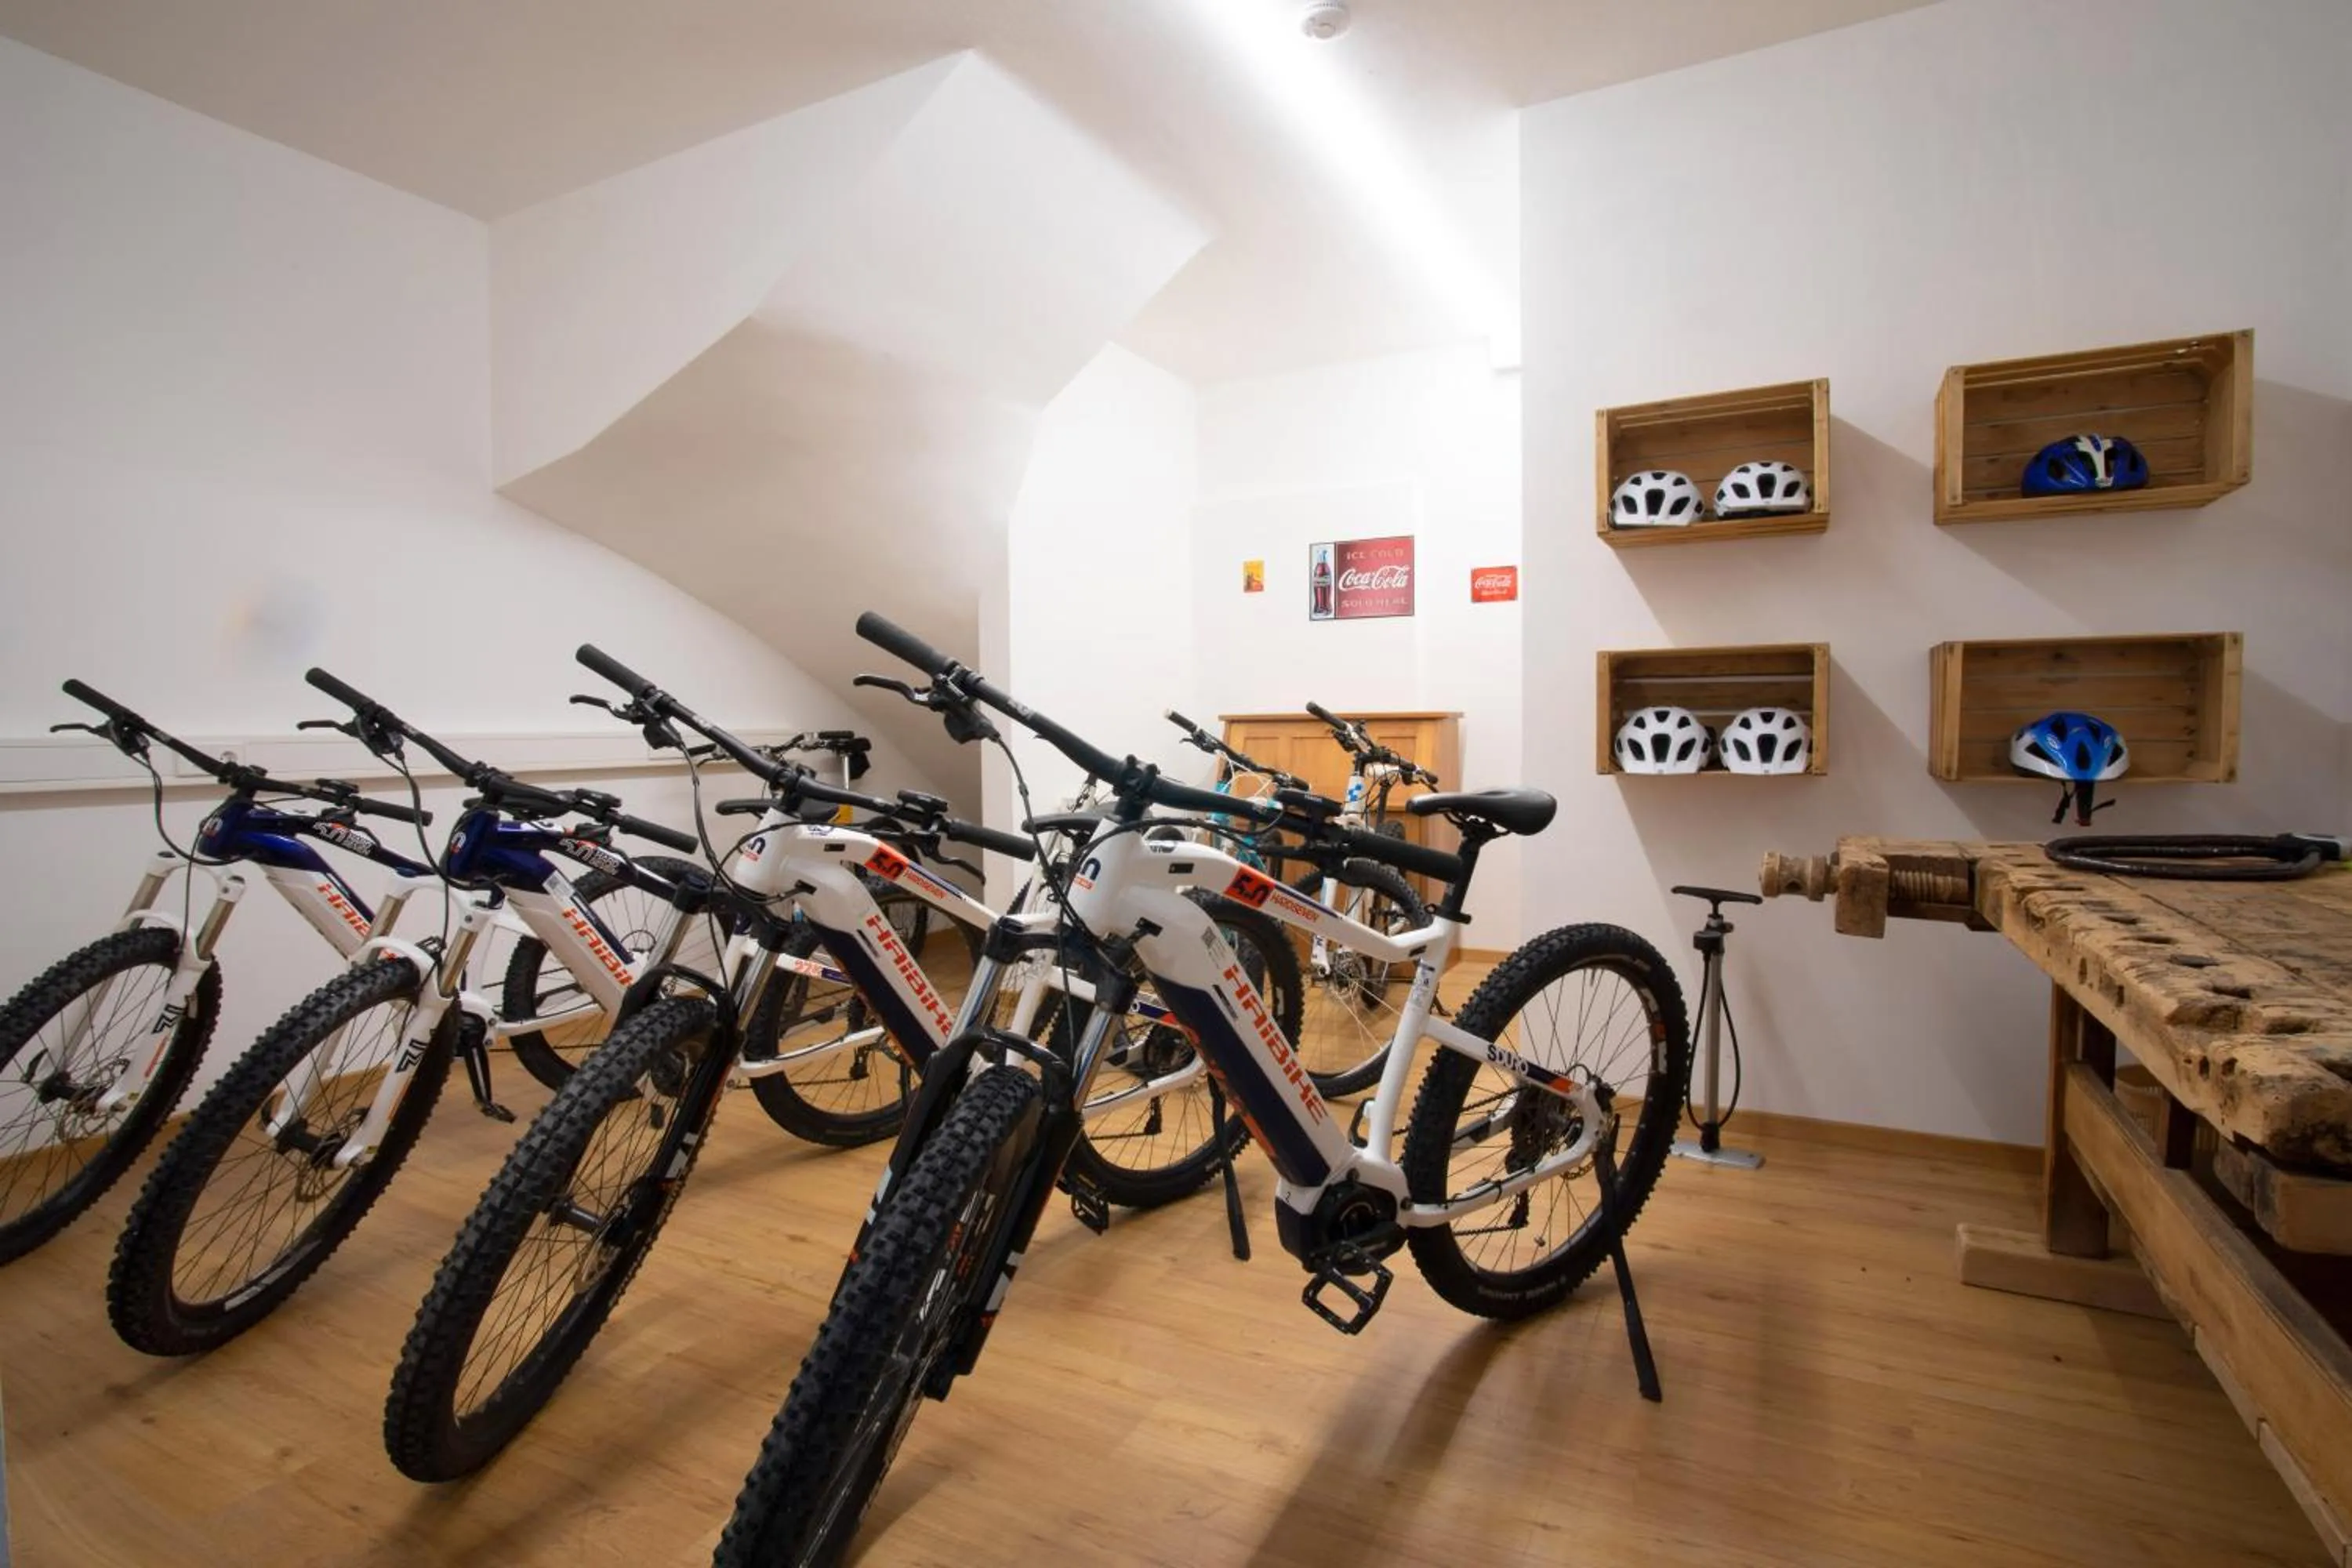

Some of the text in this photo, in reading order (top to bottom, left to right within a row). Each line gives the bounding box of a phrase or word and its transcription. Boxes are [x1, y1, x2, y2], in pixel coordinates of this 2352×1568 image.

[1347, 548, 1404, 561] ICE COLD
[1339, 564, 1410, 592] Coca-Cola
[317, 883, 372, 938] HAIB
[562, 908, 633, 986] HAIBI
